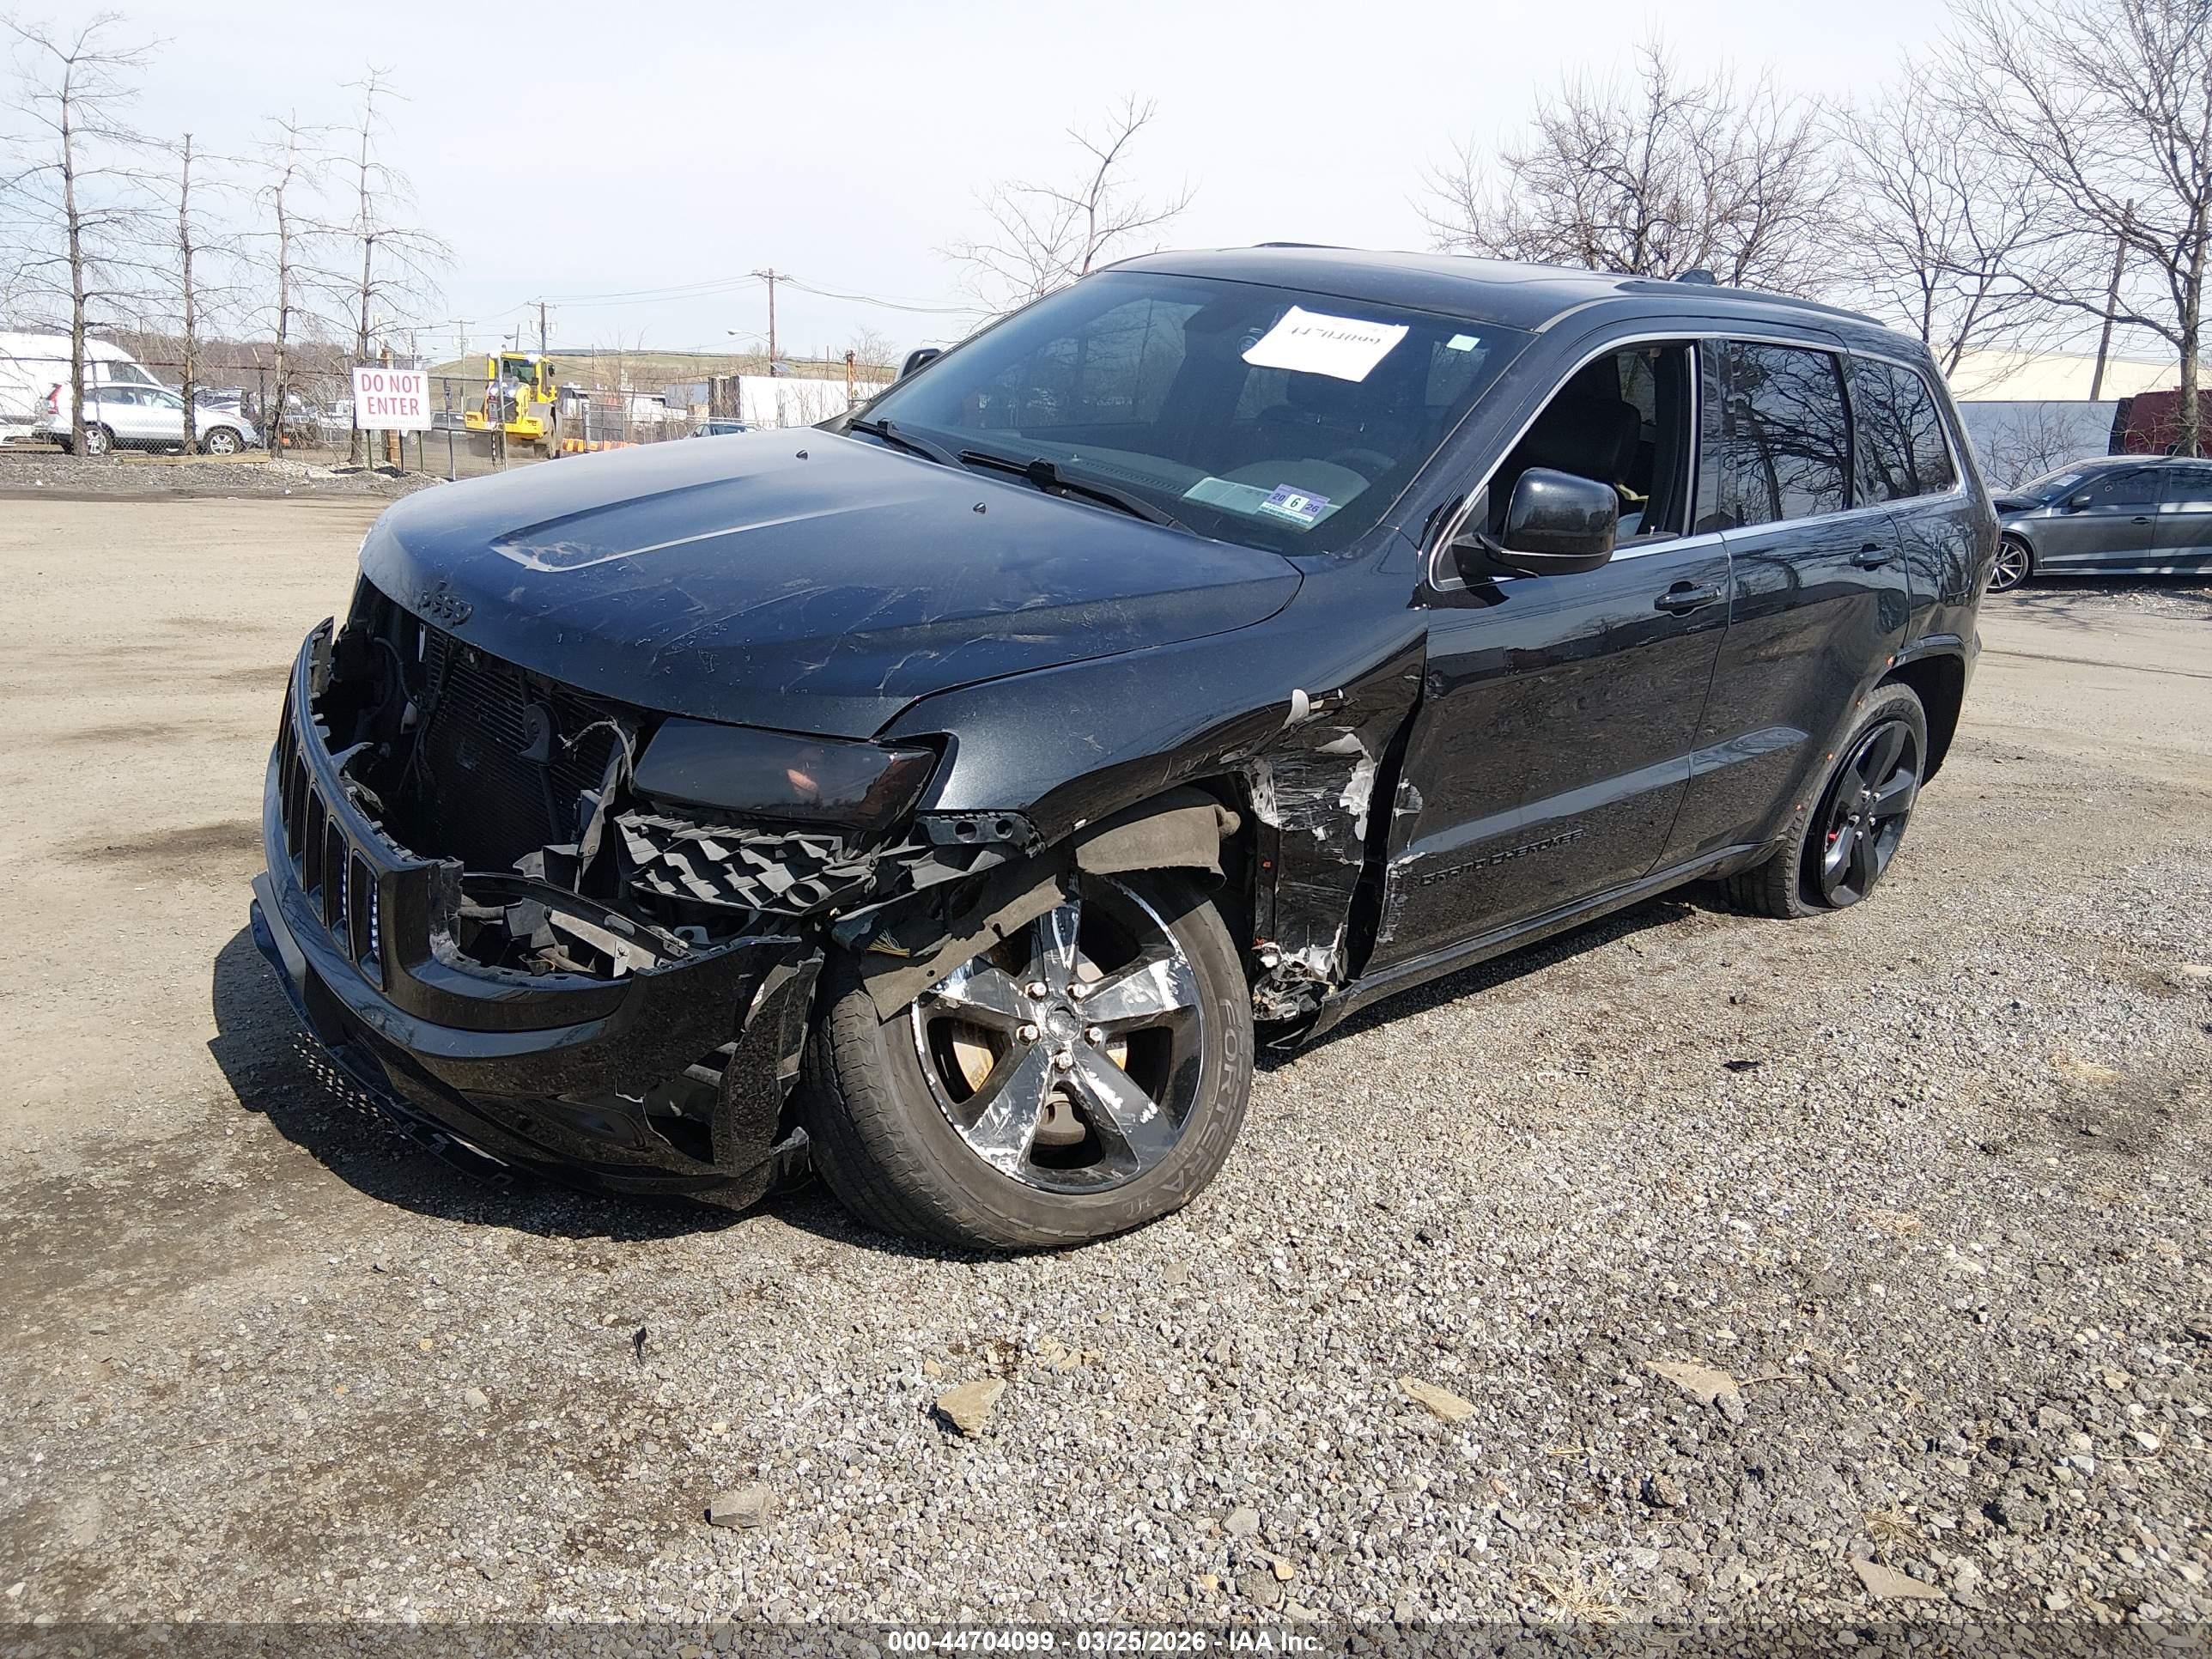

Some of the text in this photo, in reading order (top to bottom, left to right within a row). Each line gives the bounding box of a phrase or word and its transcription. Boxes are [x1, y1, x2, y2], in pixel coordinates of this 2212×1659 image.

[362, 374, 421, 393] DO NOT
[368, 396, 420, 416] ENTER
[1272, 492, 1285, 502] 20
[1290, 497, 1301, 508] 6
[1304, 503, 1320, 514] 26
[1162, 998, 1242, 1193] FORTERA
